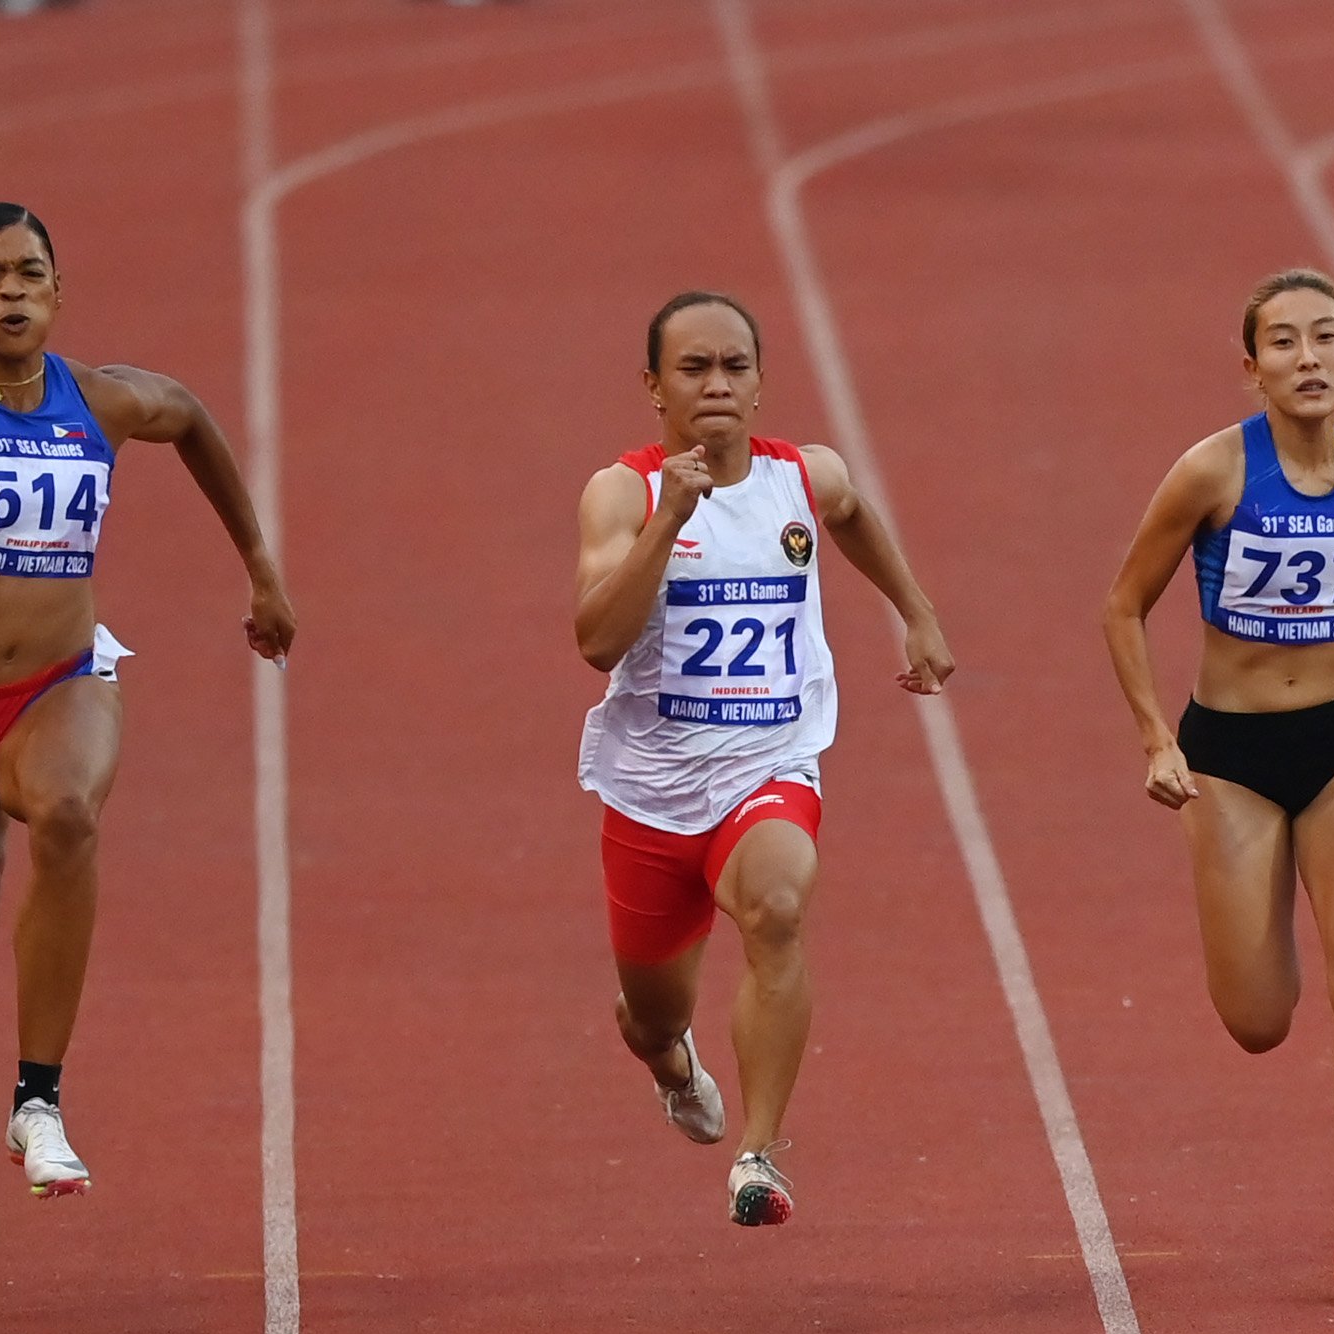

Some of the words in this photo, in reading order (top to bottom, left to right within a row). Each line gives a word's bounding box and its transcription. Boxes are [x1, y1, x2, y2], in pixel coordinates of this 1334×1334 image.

[15, 439, 41, 456] SEA
[41, 440, 85, 457] Games
[1288, 516, 1314, 534] SEA
[16, 553, 66, 574] VIETNAM
[672, 551, 703, 560] NING
[723, 581, 747, 601] SEA
[750, 581, 789, 600] Games
[1227, 615, 1265, 638] HANOI
[1277, 620, 1331, 640] VIETNAM
[681, 617, 797, 677] 221
[711, 687, 771, 695] INDONESIA
[670, 699, 710, 720] HANOI
[721, 700, 775, 720] VIETNAM
